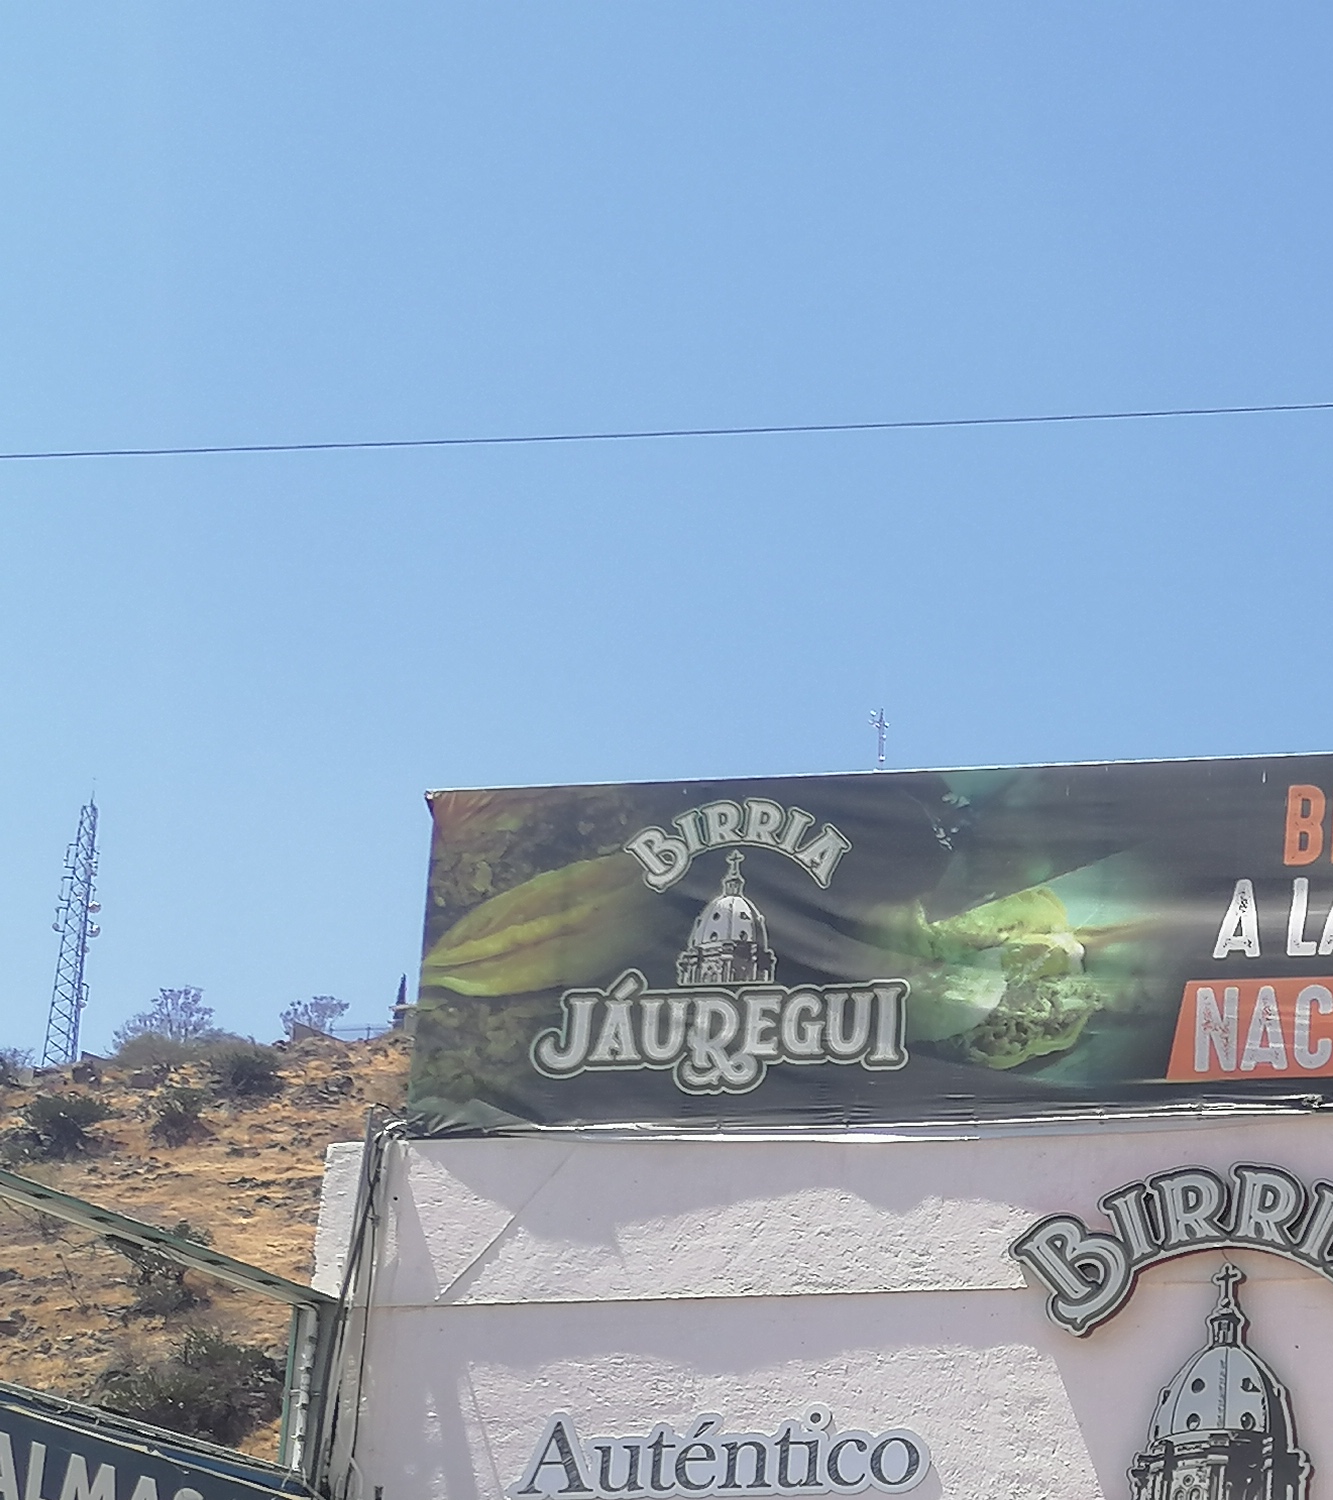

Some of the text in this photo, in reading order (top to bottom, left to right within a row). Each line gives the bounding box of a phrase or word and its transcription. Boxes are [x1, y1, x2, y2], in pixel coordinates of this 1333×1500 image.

[626, 798, 850, 891] BIRRIA
[1211, 878, 1261, 959] A
[532, 970, 909, 1093] JÁUREGUI
[515, 1411, 923, 1497] Auténtico
